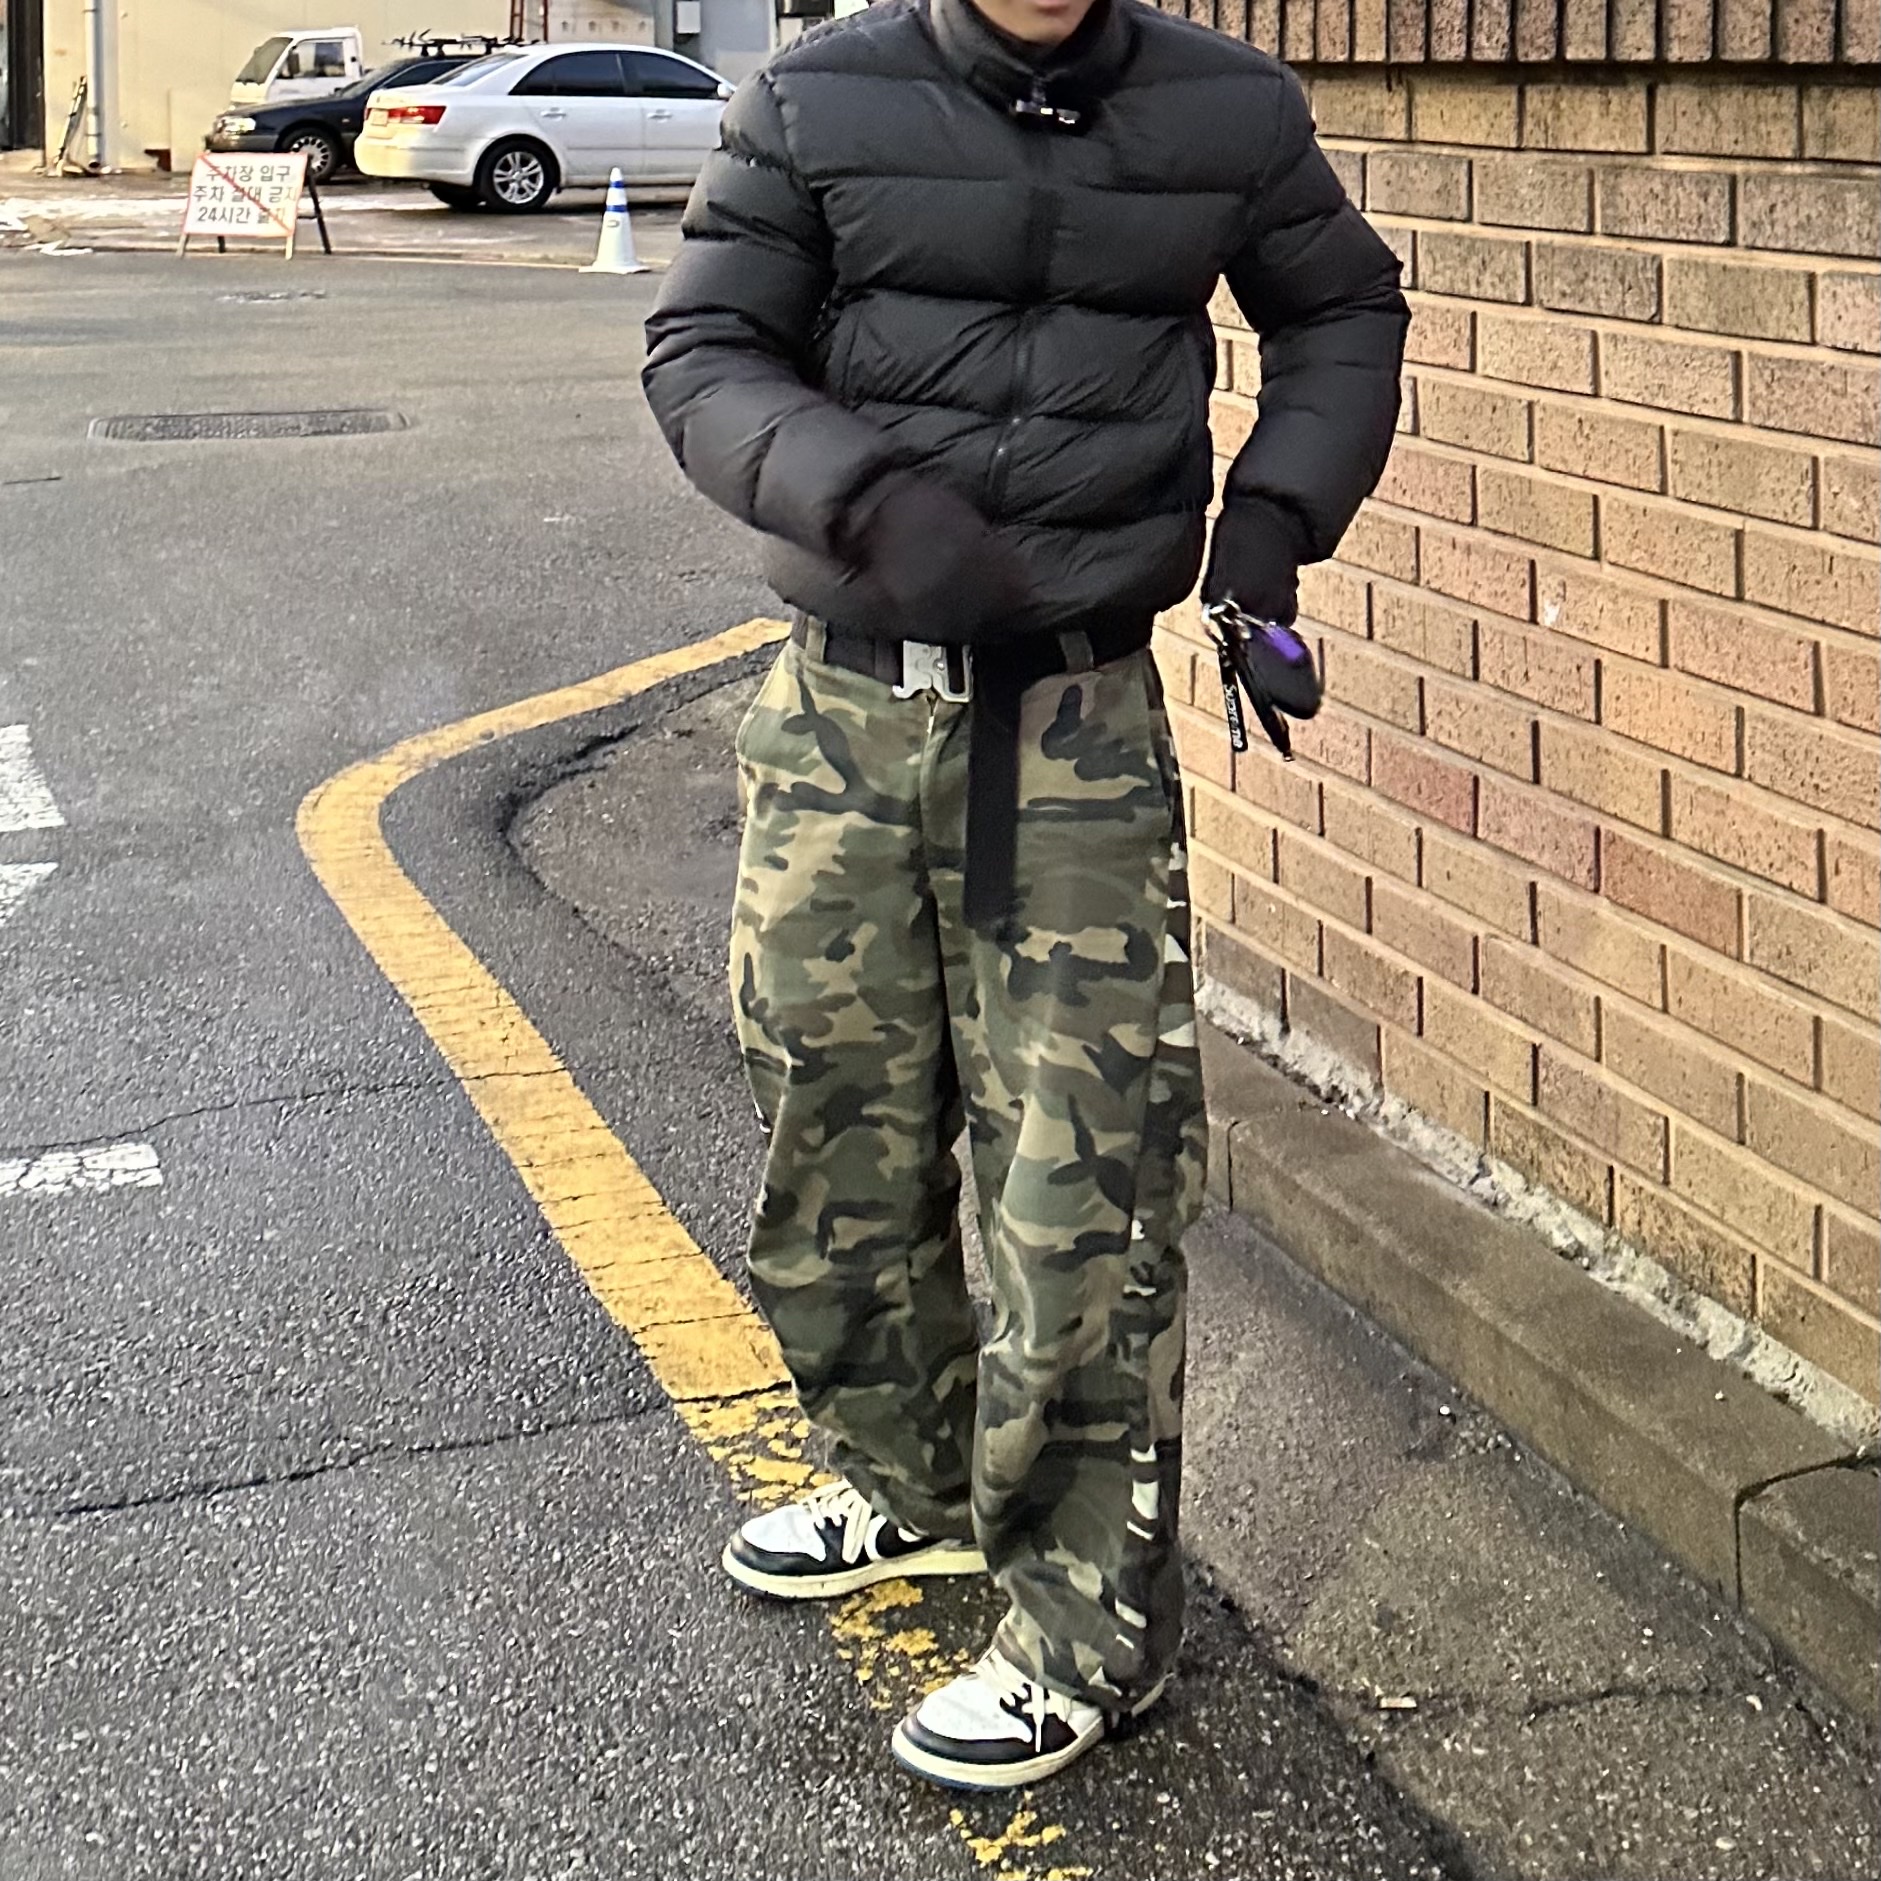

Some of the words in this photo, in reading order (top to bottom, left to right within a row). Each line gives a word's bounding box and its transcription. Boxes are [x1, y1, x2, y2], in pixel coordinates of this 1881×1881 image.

[259, 165, 291, 183] 입구
[193, 185, 225, 203] 주차
[197, 206, 251, 224] 24시간
